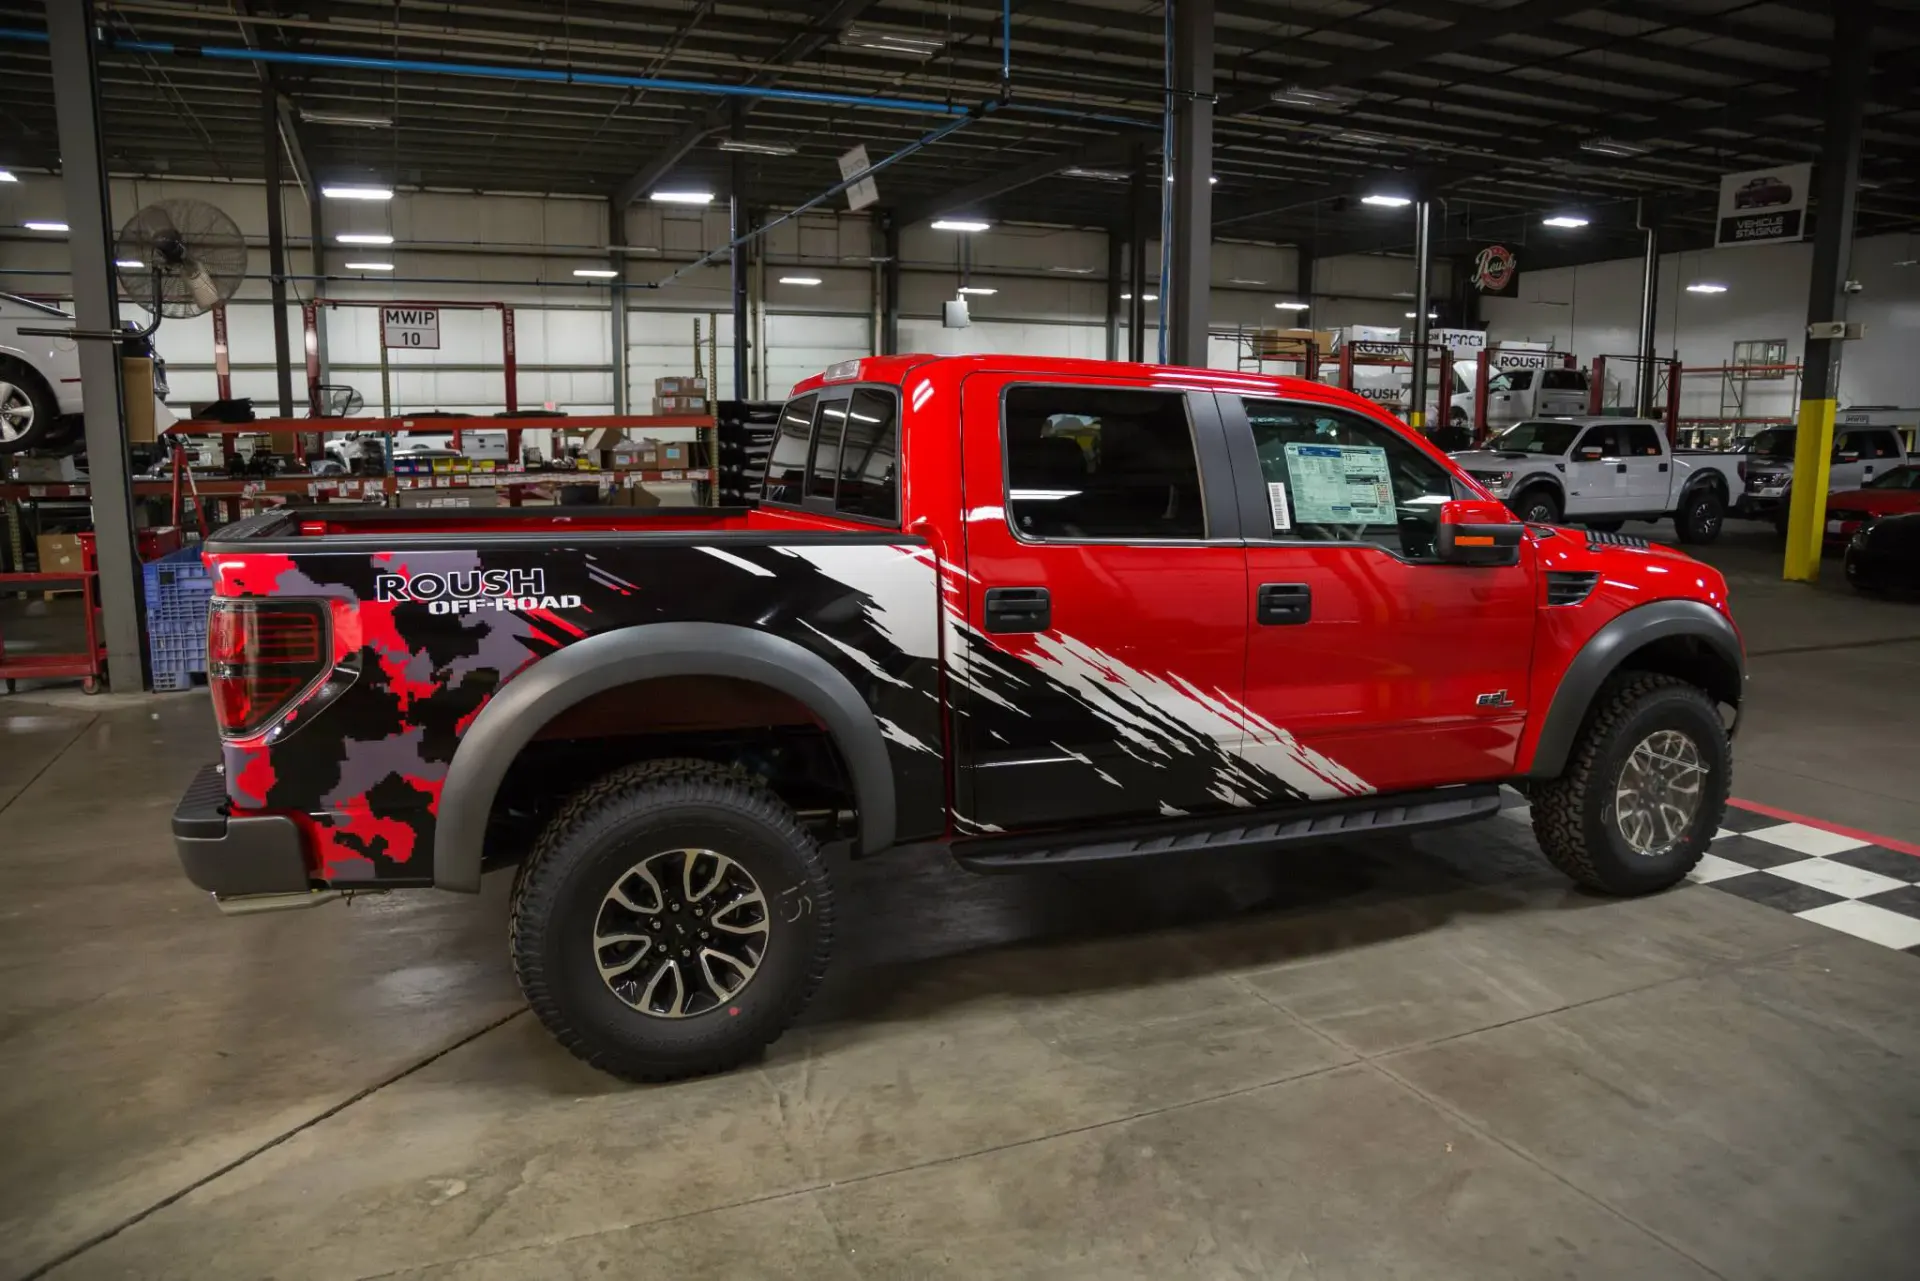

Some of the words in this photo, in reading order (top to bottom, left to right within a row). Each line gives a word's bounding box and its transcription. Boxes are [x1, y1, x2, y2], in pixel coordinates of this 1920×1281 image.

[1736, 216, 1784, 229] VEHICLE
[1735, 225, 1784, 239] STAGING
[386, 310, 435, 325] MWIP
[401, 332, 421, 346] 10
[1500, 356, 1545, 369] ROUSH
[376, 568, 546, 603] ROUSH
[428, 594, 582, 615] OFF-ROAD
